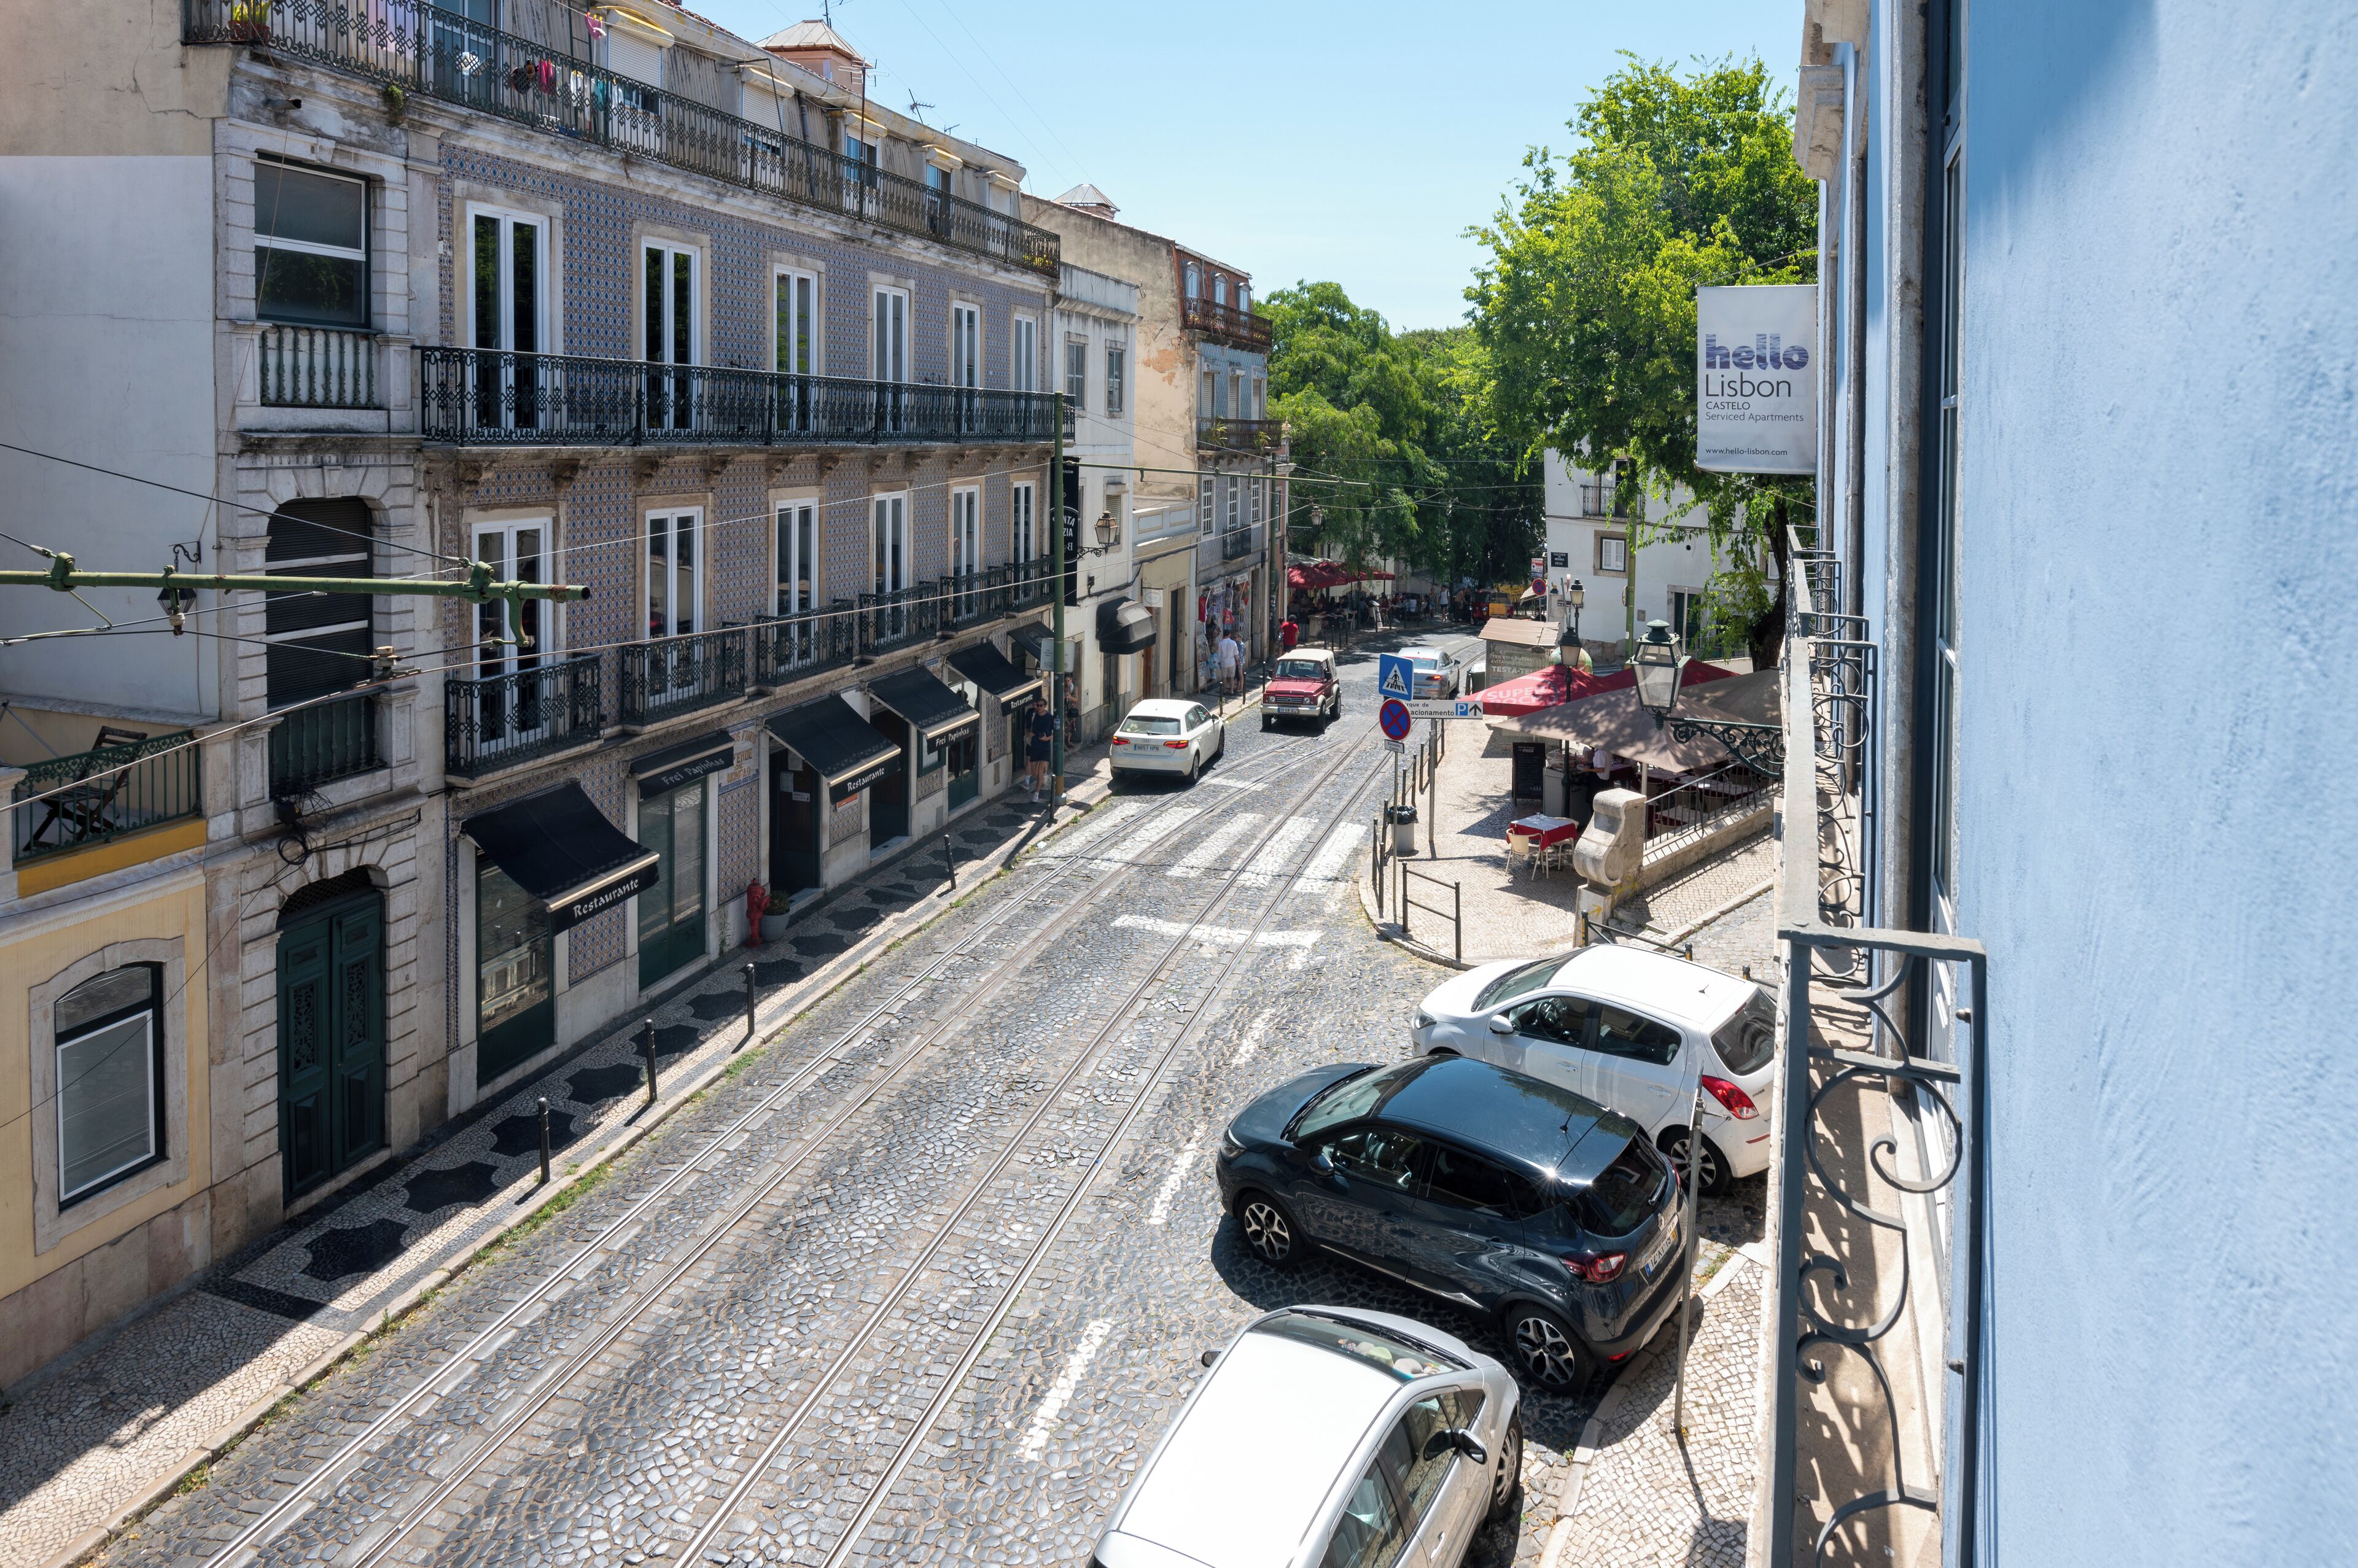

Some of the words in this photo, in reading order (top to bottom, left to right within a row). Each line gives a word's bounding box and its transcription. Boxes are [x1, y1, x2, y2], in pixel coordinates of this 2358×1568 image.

[1706, 333, 1809, 370] hello
[1706, 372, 1791, 398] Lisbon
[1706, 401, 1750, 410] CASTELO
[1706, 412, 1745, 421] Serviced
[1748, 413, 1804, 423] Apartments
[1705, 448, 1788, 456] www.hello-lisbon.com
[1011, 694, 1033, 710] Restaurante
[936, 735, 946, 747] Frei
[948, 728, 970, 742] Papinhas
[661, 772, 683, 786] Frei
[683, 758, 725, 776] Papinhas
[847, 767, 885, 792] Restaurante
[573, 879, 639, 918] Restaurante
